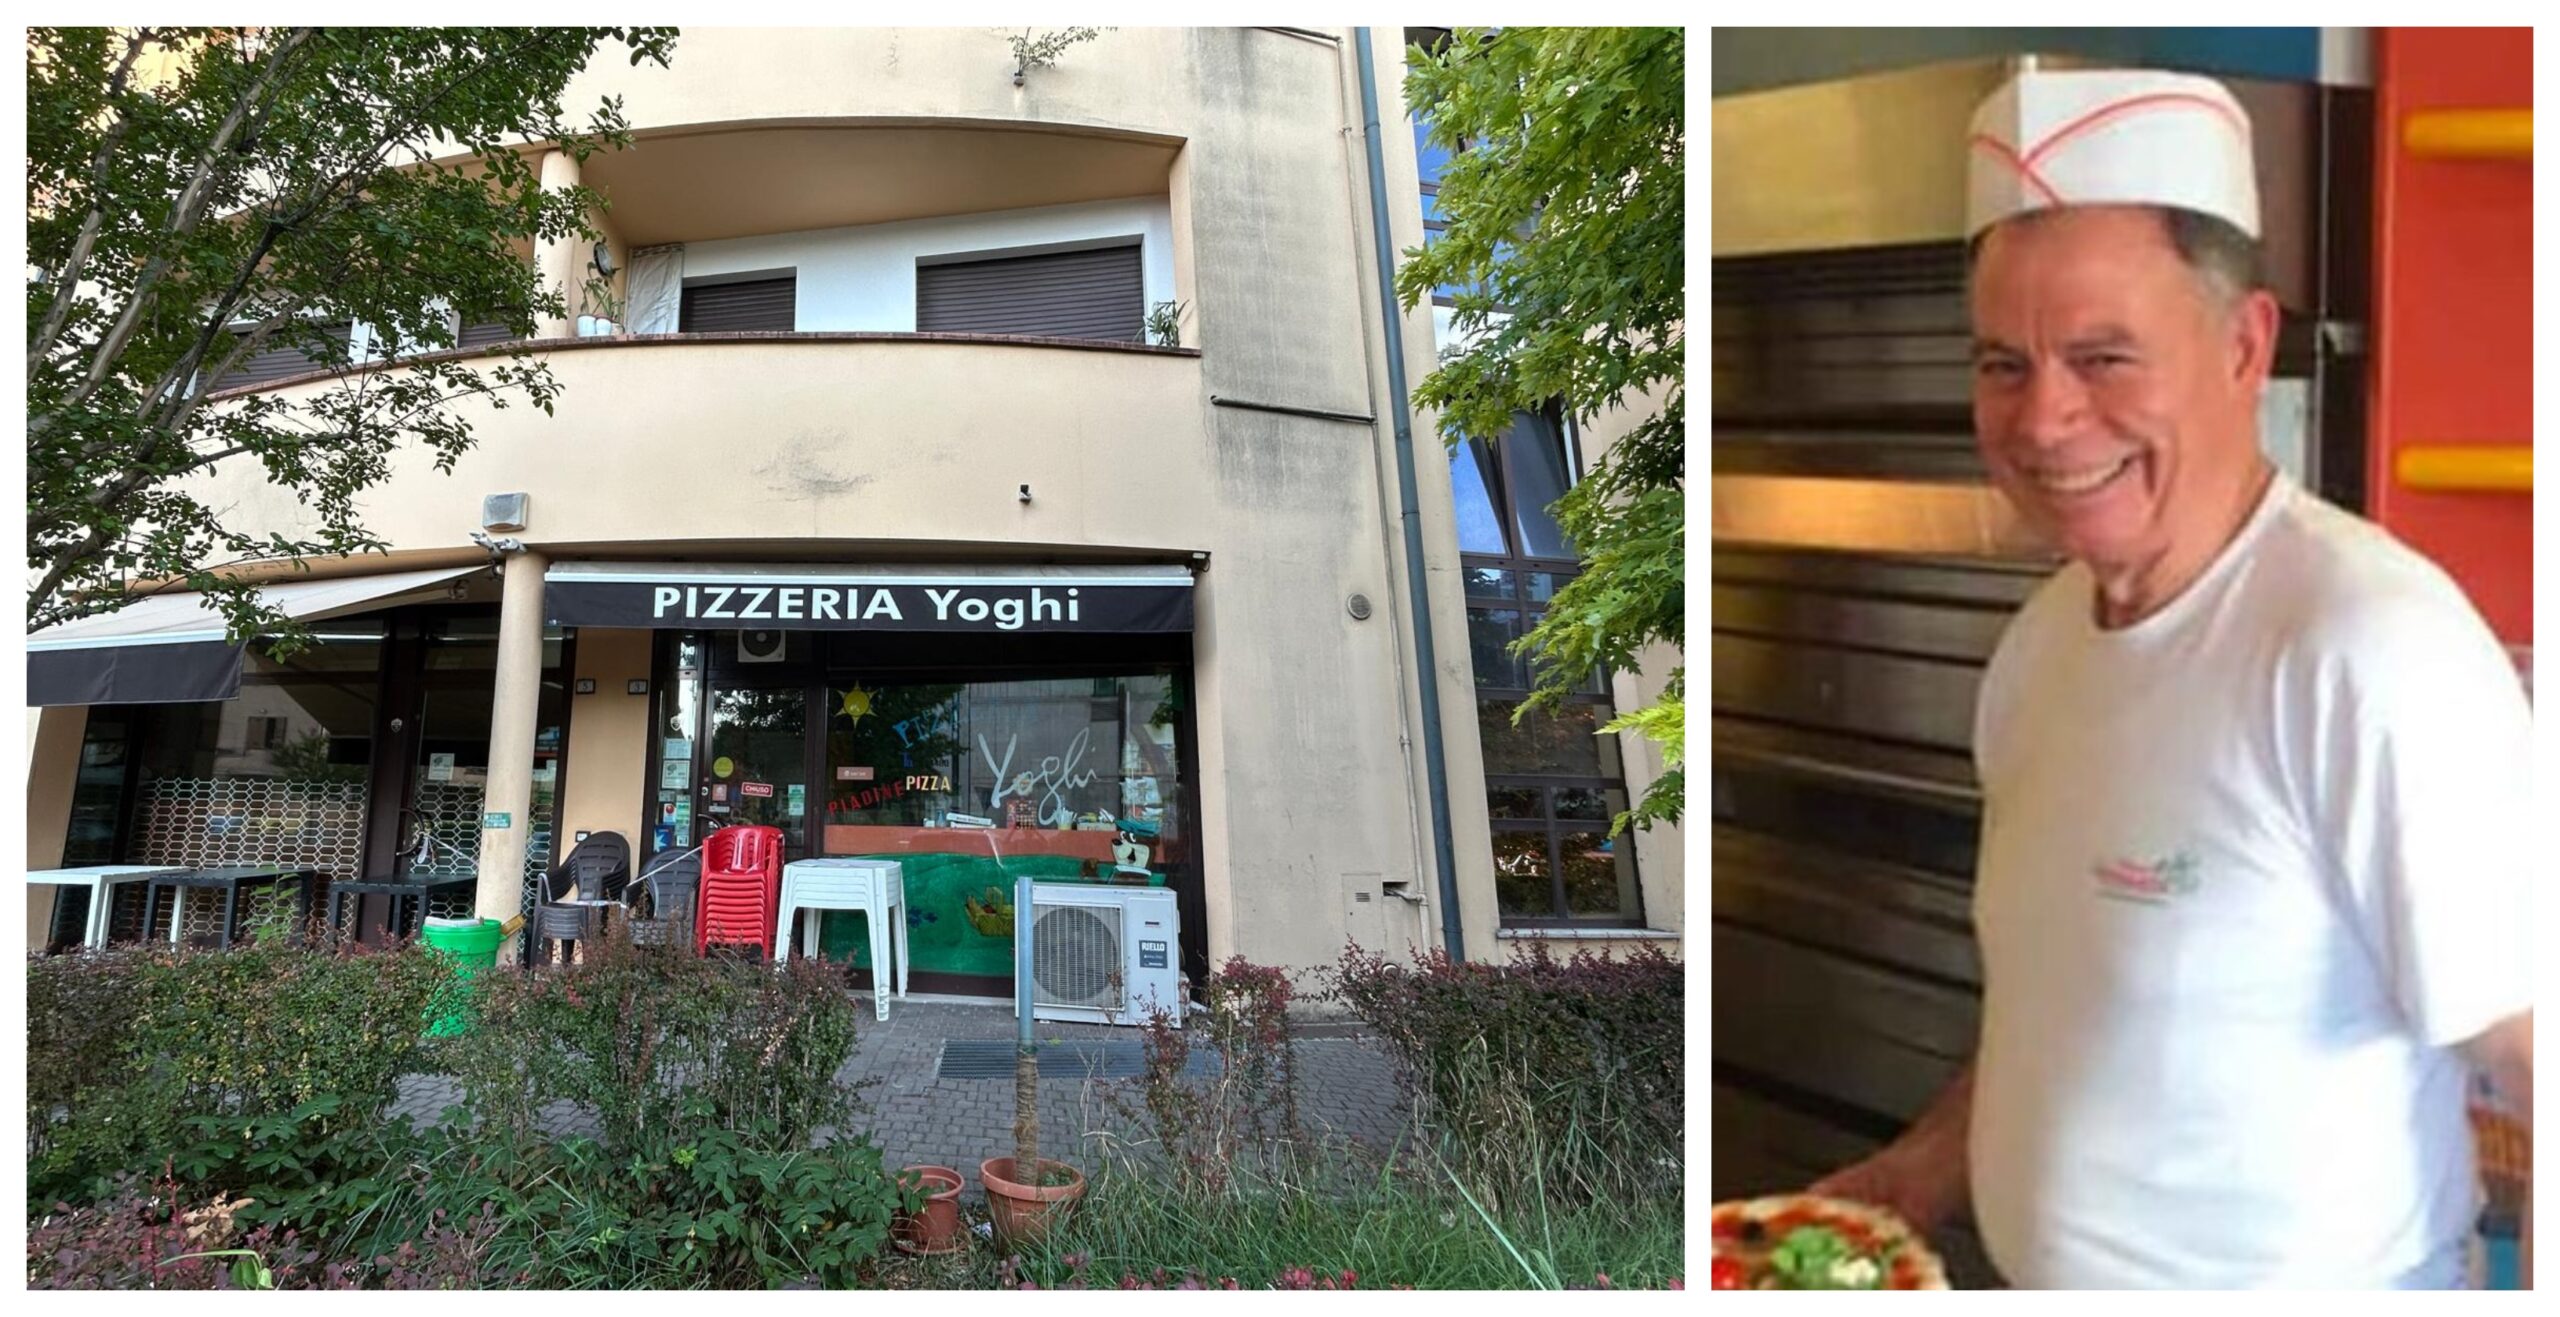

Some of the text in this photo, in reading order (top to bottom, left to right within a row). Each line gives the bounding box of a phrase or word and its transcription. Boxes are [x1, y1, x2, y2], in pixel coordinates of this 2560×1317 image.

[653, 586, 1080, 630] PIZZERIA Yoghi
[744, 784, 770, 795] CHIUSO
[906, 775, 952, 791] PIZZA
[977, 727, 1098, 826] Yoghi
[827, 779, 905, 816] PIADINE
